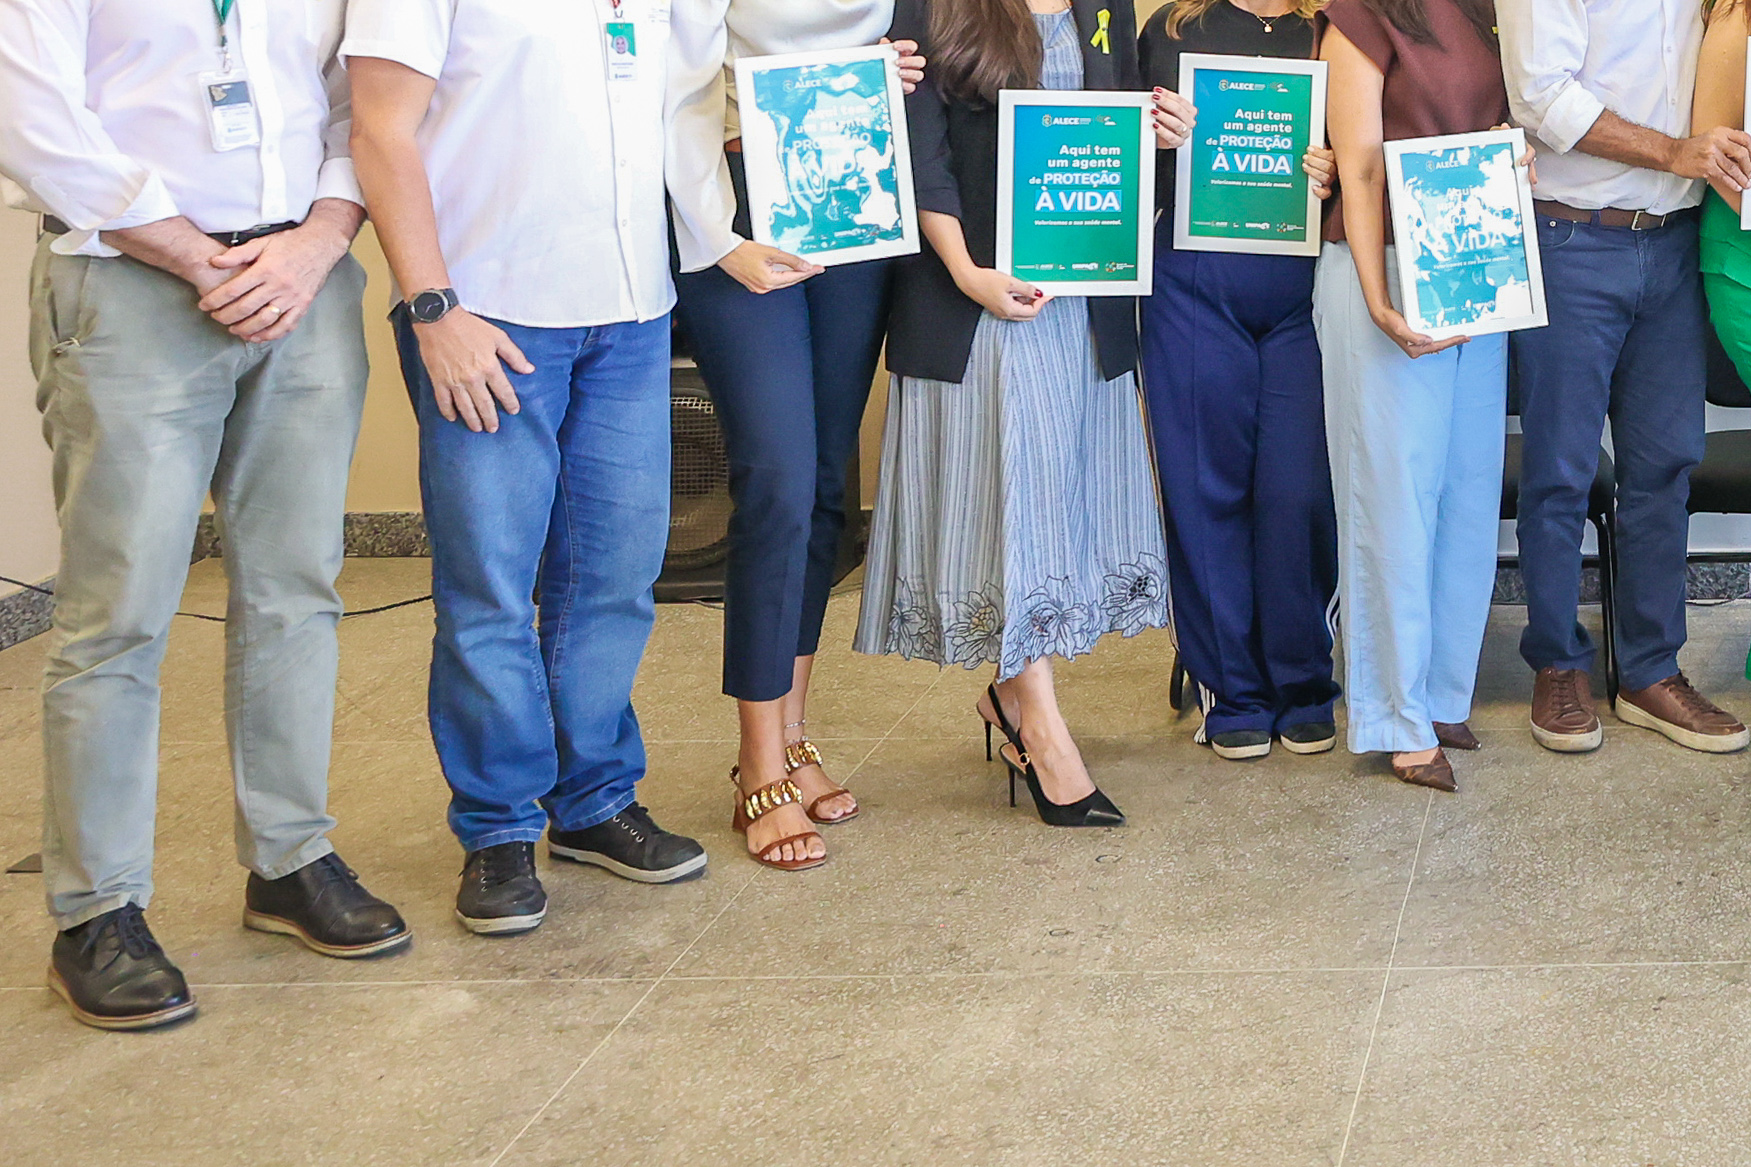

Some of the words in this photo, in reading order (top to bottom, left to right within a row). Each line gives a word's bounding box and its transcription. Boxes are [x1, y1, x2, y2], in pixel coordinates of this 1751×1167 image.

[794, 79, 822, 89] ALECE
[1229, 83, 1255, 91] ALECE
[1235, 108, 1265, 121] Aqui
[1267, 110, 1293, 121] tem
[1053, 117, 1080, 125] ALECE
[1224, 122, 1244, 131] um
[1246, 122, 1293, 134] agente
[1206, 137, 1218, 146] de
[1219, 135, 1292, 151] PROTEÇÃO
[1059, 144, 1091, 156] Aqui
[1094, 145, 1121, 155] tem
[1048, 159, 1068, 168] um
[1072, 158, 1121, 169] agente
[1212, 147, 1230, 171] À
[1234, 153, 1291, 174] VIDA
[1435, 161, 1459, 170] ALECE
[1029, 177, 1042, 185] de
[1044, 170, 1121, 188] PROTEÇÃO
[1210, 179, 1242, 187] Valorizamos
[1035, 186, 1055, 211] À
[1059, 191, 1121, 211] VIDA
[1451, 231, 1507, 253] VIDA
